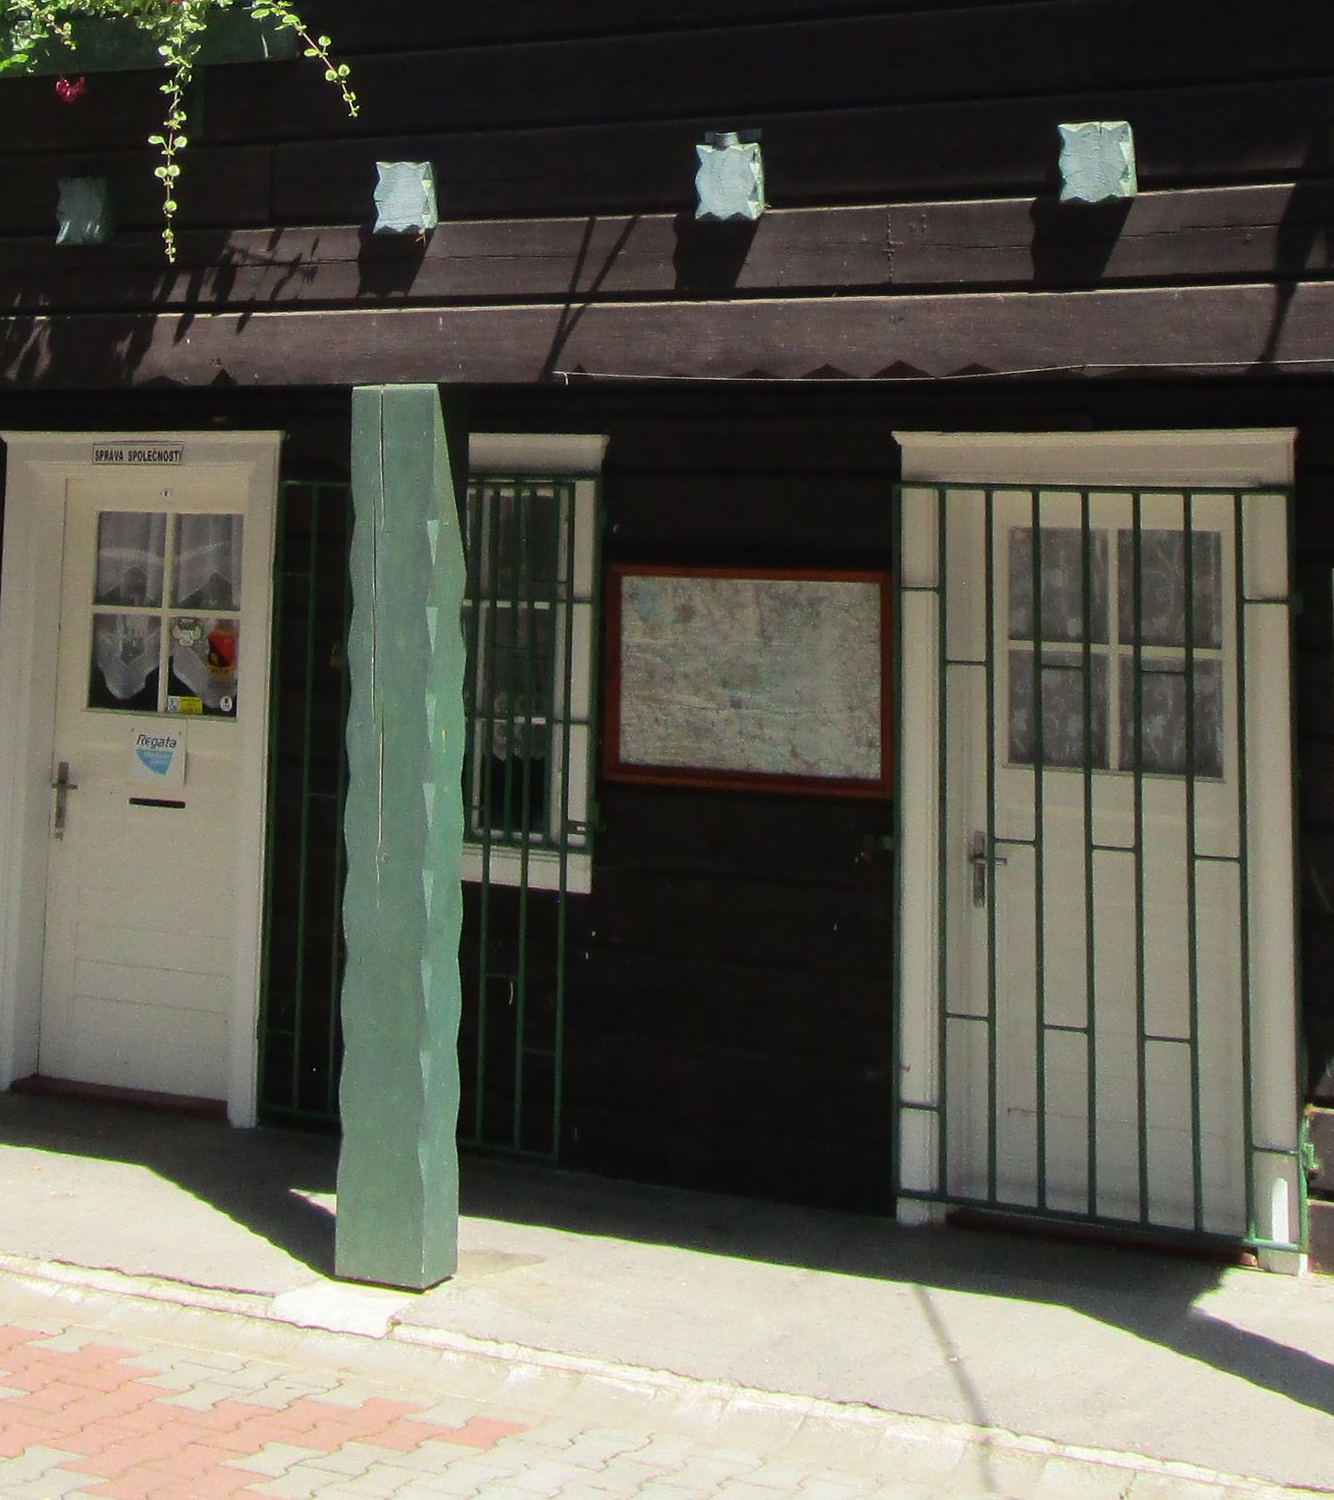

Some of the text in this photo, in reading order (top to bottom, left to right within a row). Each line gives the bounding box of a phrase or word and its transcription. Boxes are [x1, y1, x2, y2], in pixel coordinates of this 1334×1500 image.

[95, 447, 182, 462] SPRÁVA SPOLEČNOSTI
[135, 733, 178, 750] Regata
